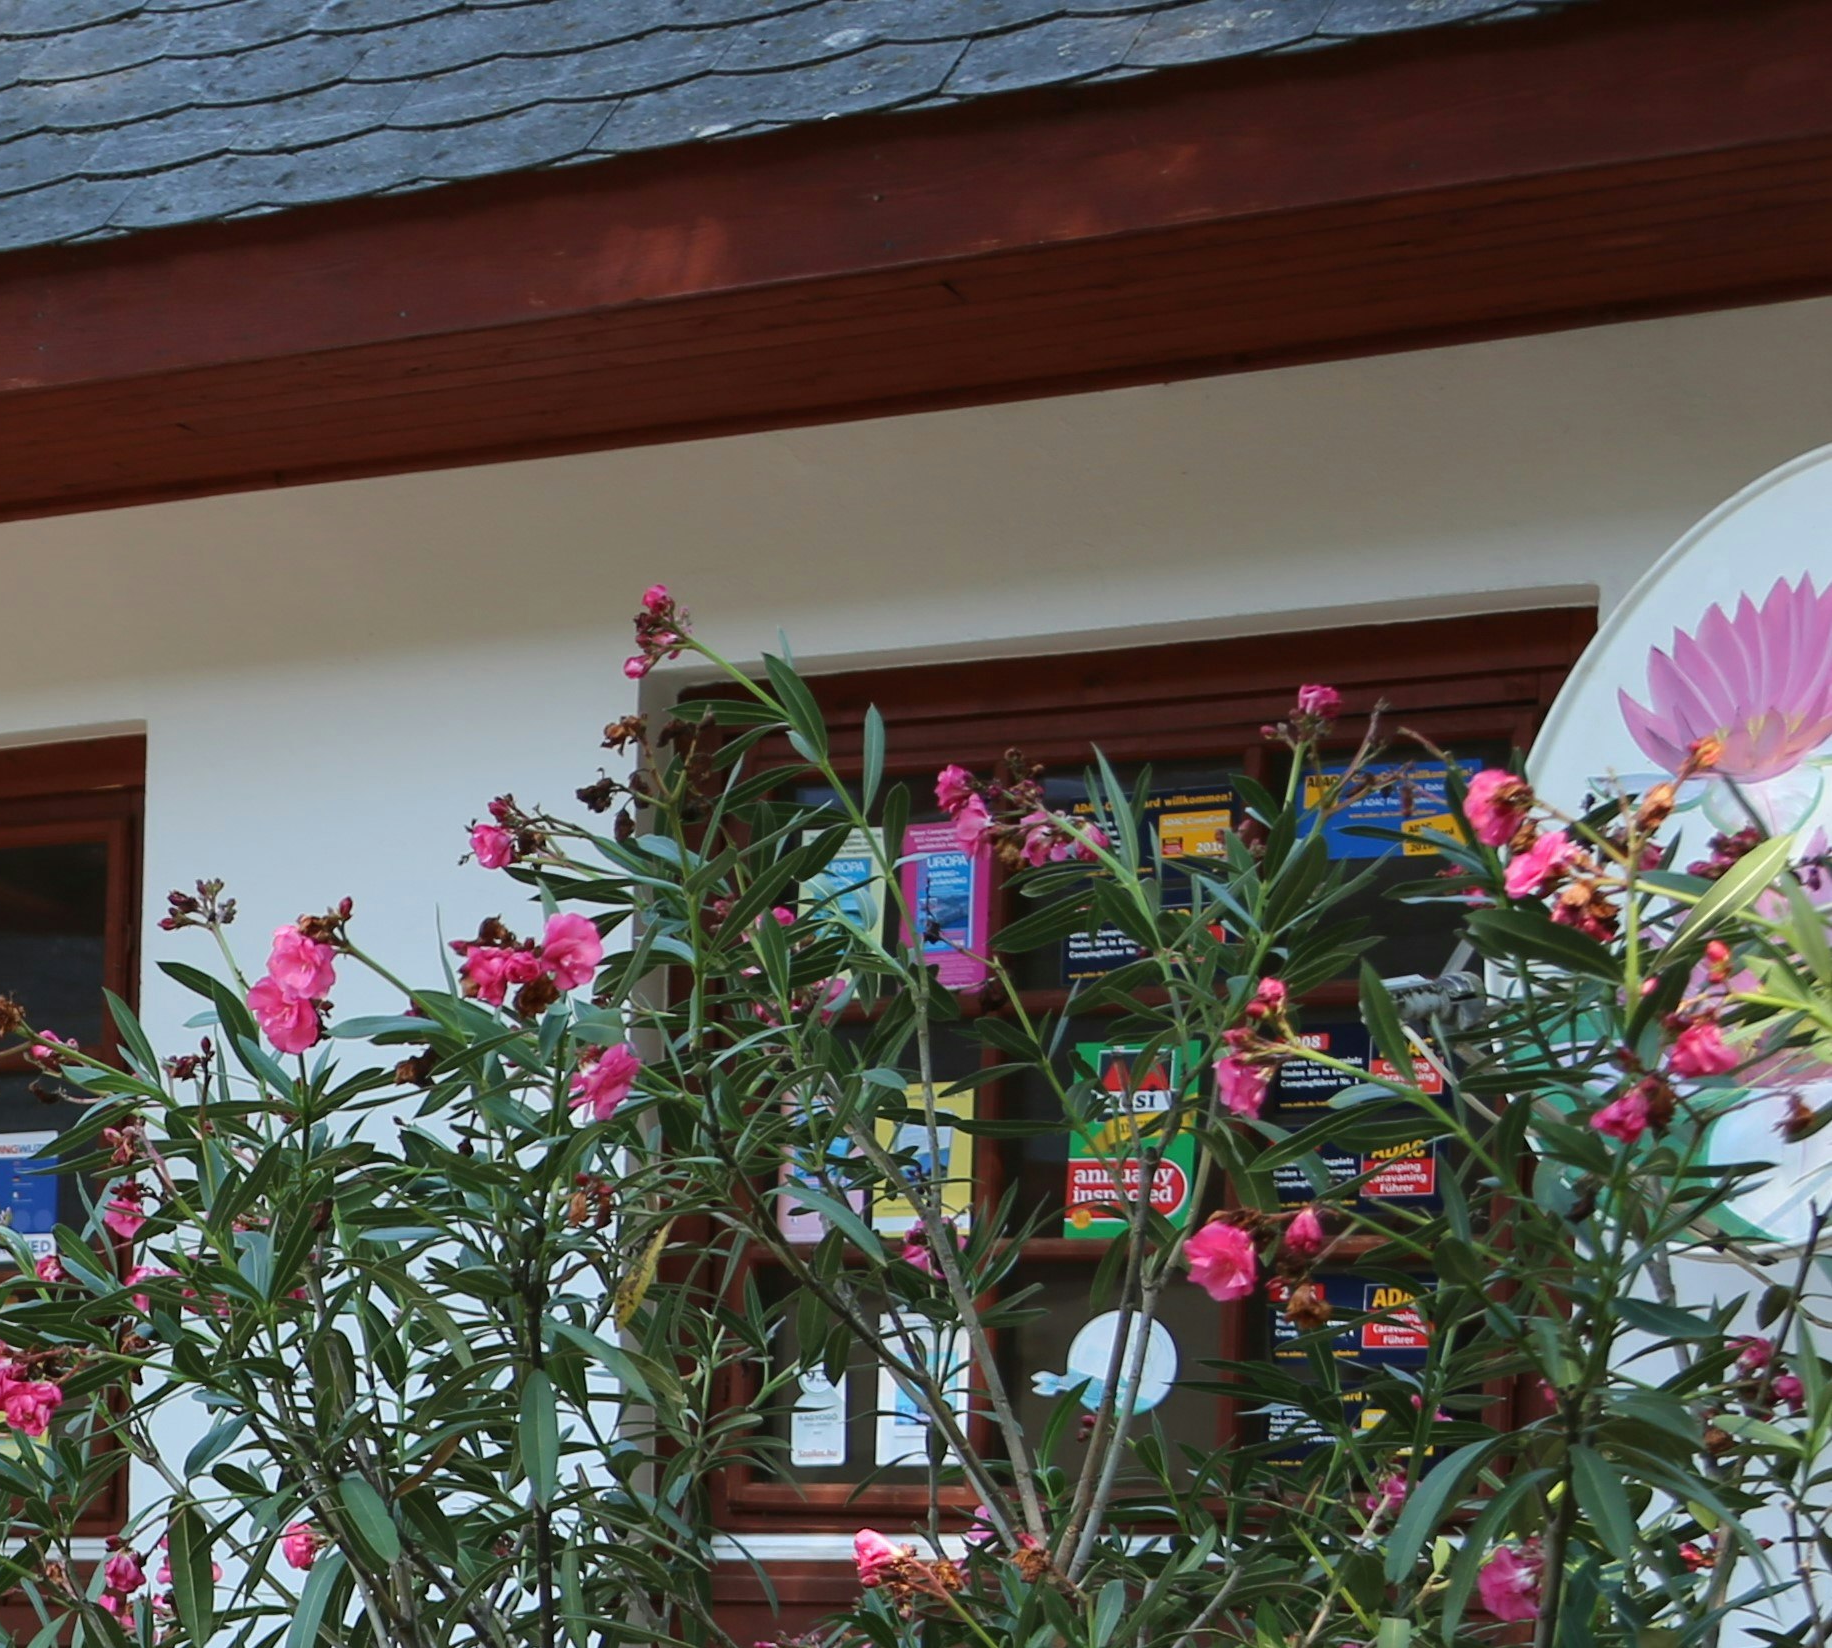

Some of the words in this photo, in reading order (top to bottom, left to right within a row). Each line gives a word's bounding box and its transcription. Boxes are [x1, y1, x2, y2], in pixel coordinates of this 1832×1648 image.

[1164, 792, 1233, 807] willkommen!
[826, 861, 866, 873] UROPA
[927, 855, 969, 868] UROPA
[1069, 948, 1125, 959] Campingführer
[1281, 1079, 1337, 1088] Campingführer
[1371, 1172, 1427, 1184] aravaning
[1380, 1183, 1414, 1193] Führer
[1383, 1334, 1414, 1345] Führer
